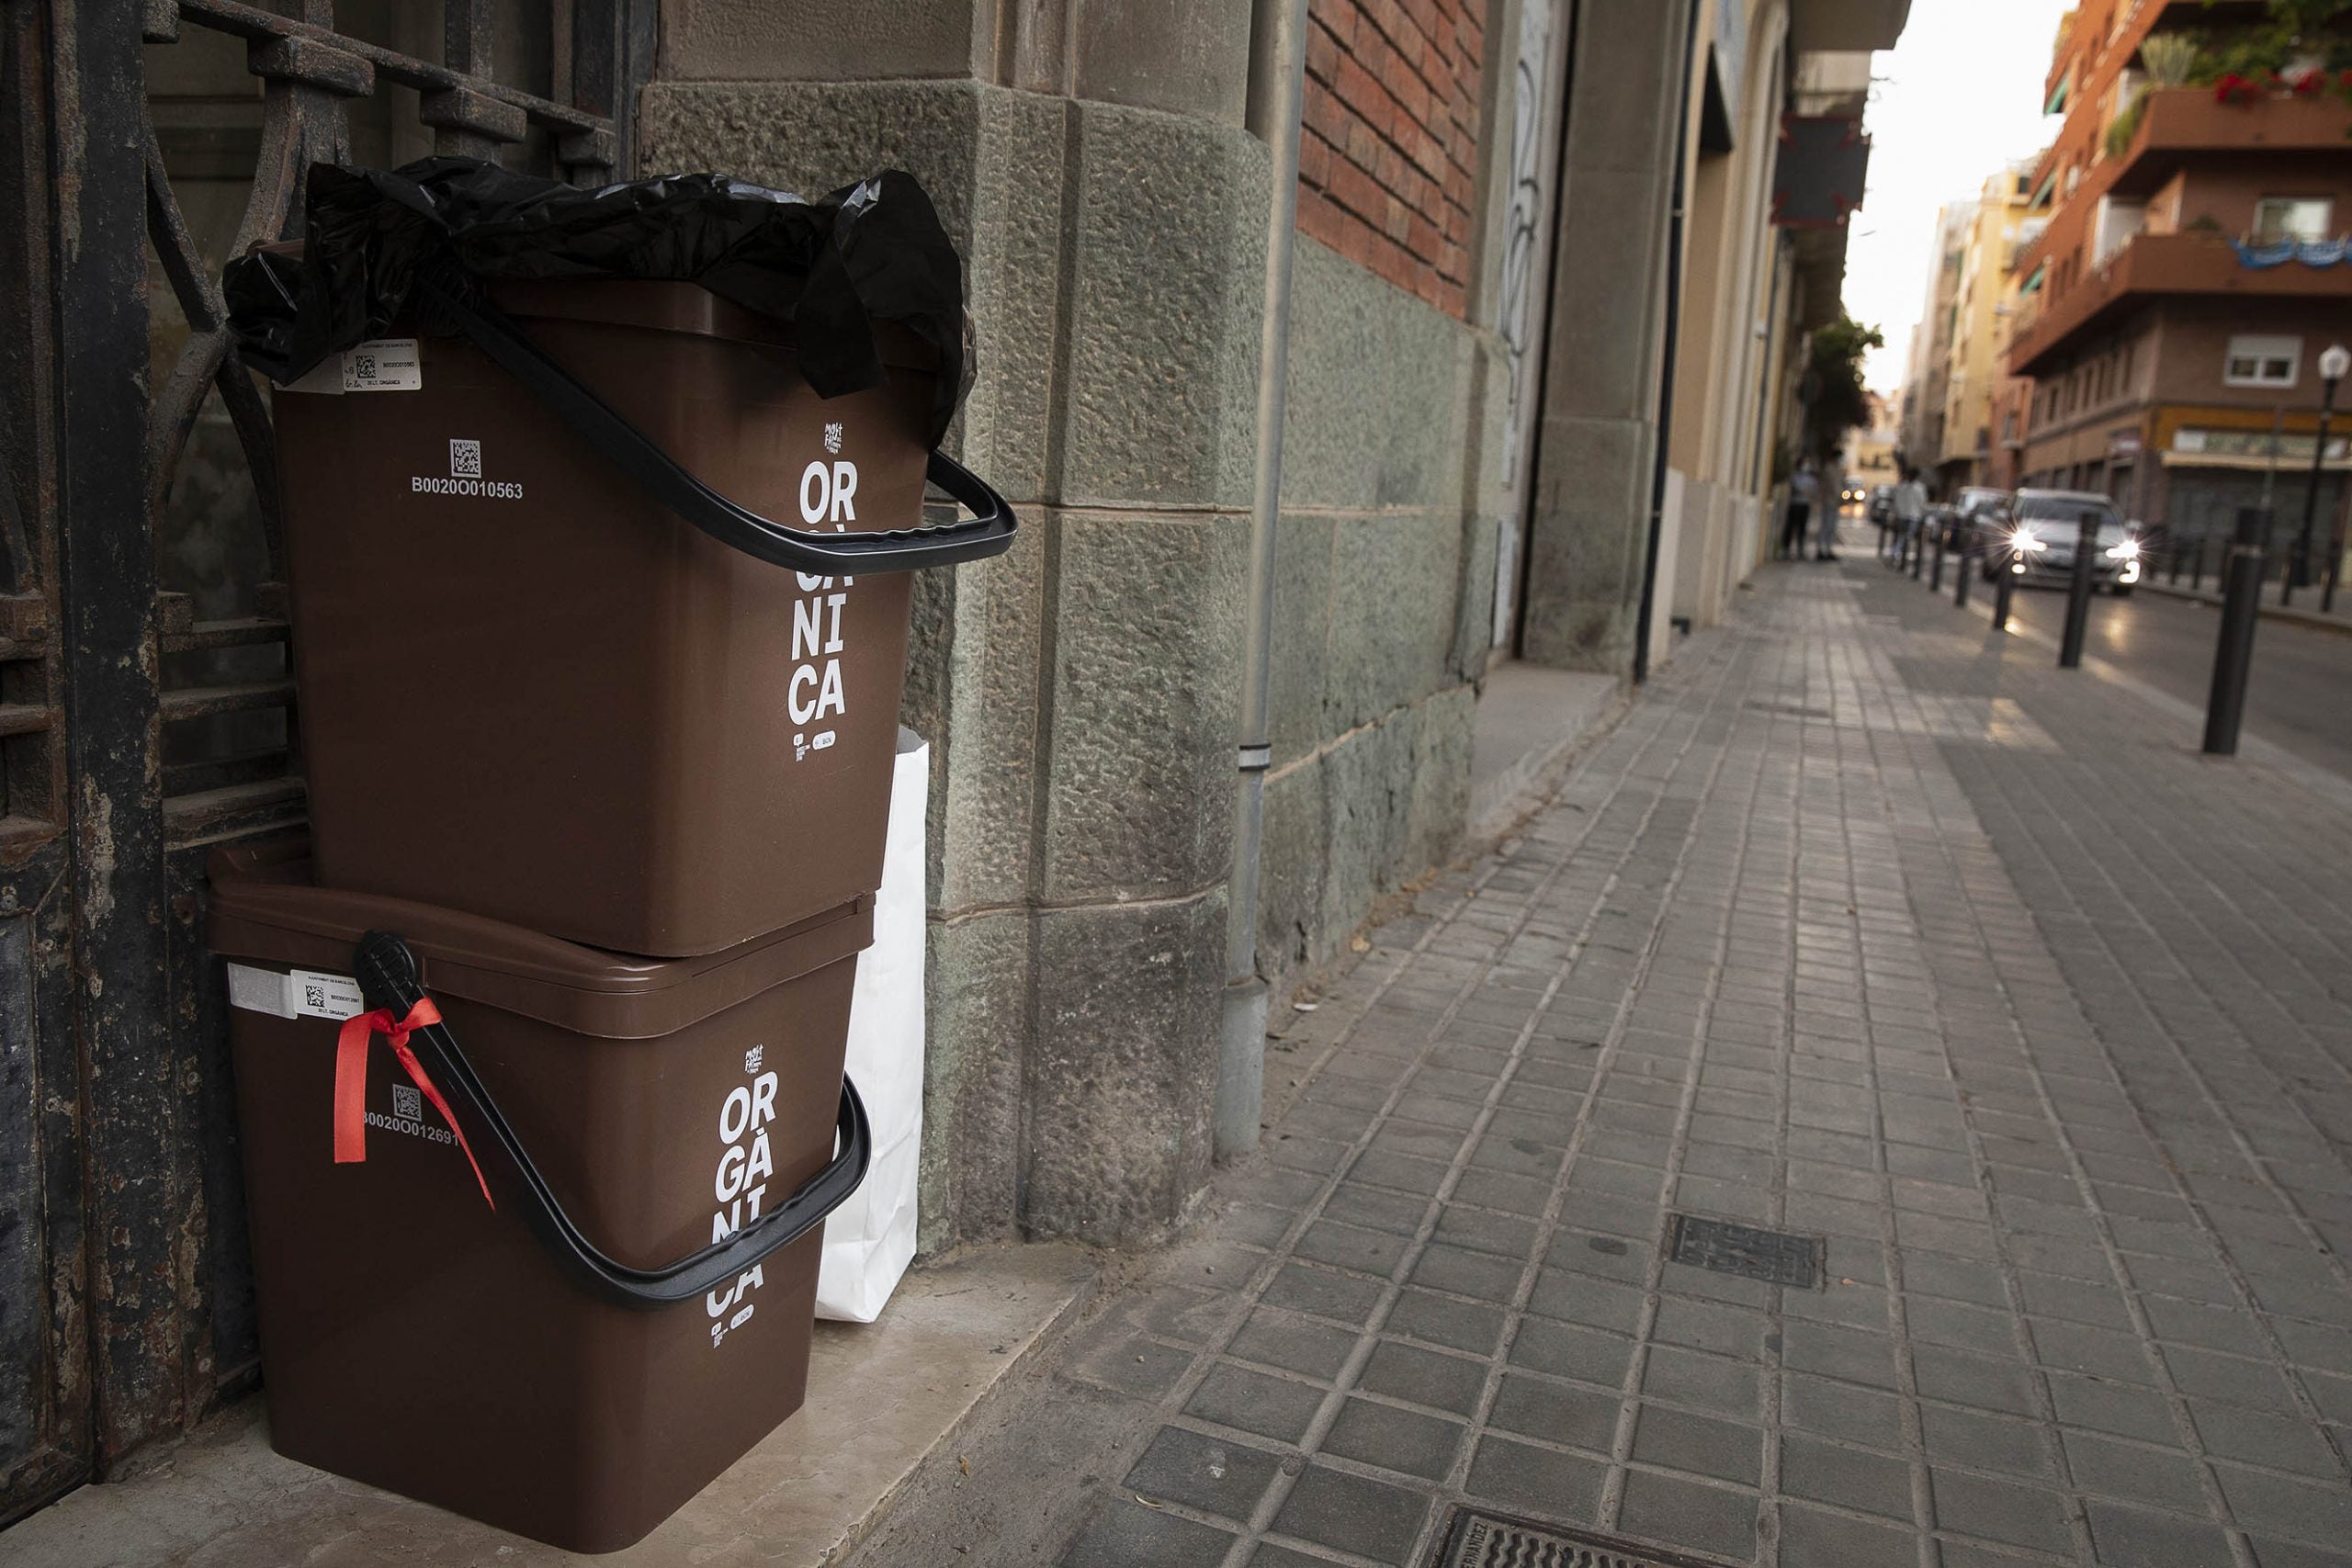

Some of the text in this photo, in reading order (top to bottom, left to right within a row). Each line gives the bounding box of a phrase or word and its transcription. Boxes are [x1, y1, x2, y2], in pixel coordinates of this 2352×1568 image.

[799, 460, 858, 525] OR
[791, 592, 846, 661] NI
[787, 658, 845, 726] CA
[719, 1071, 778, 1145] OR
[715, 1126, 774, 1203] GÀ
